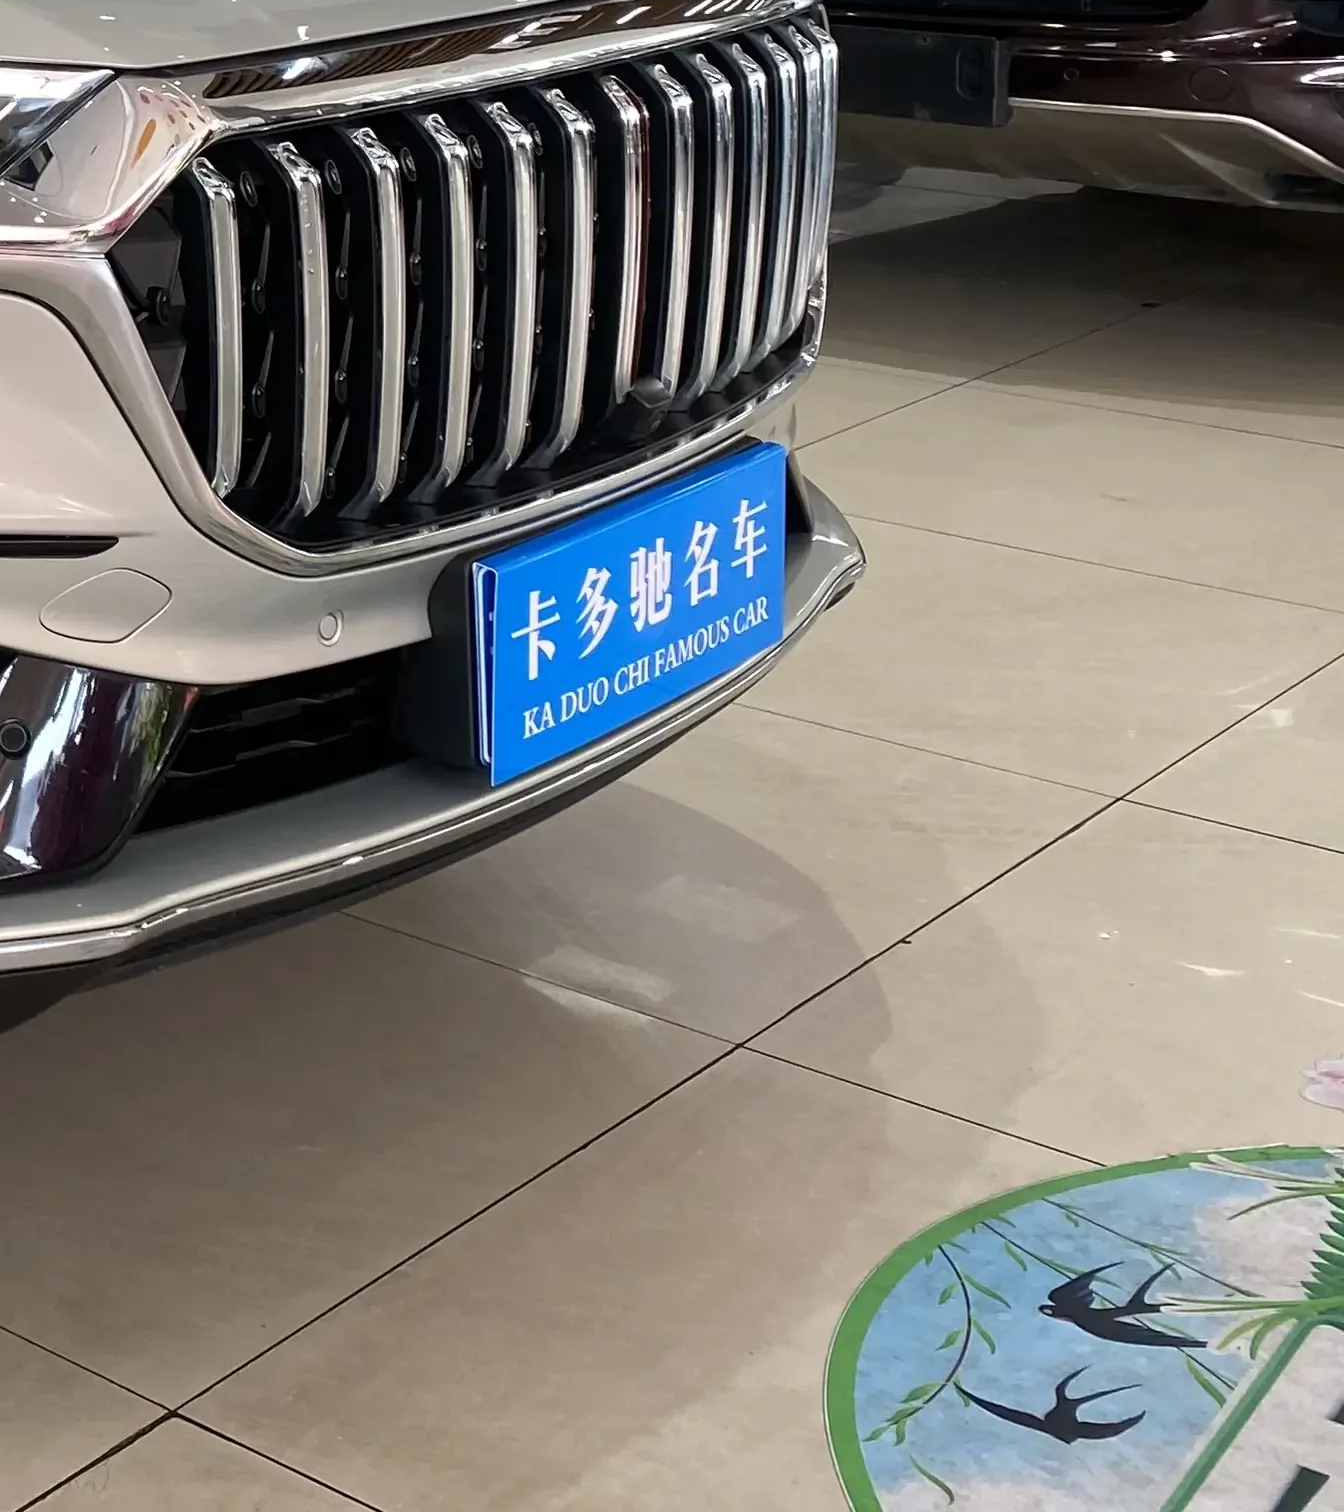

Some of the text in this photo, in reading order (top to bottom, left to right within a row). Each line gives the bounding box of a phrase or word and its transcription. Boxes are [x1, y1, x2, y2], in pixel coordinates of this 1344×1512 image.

[511, 499, 768, 680] 卡多驰名车
[523, 596, 768, 739] KA DUO CHI FAMOUS CAR
